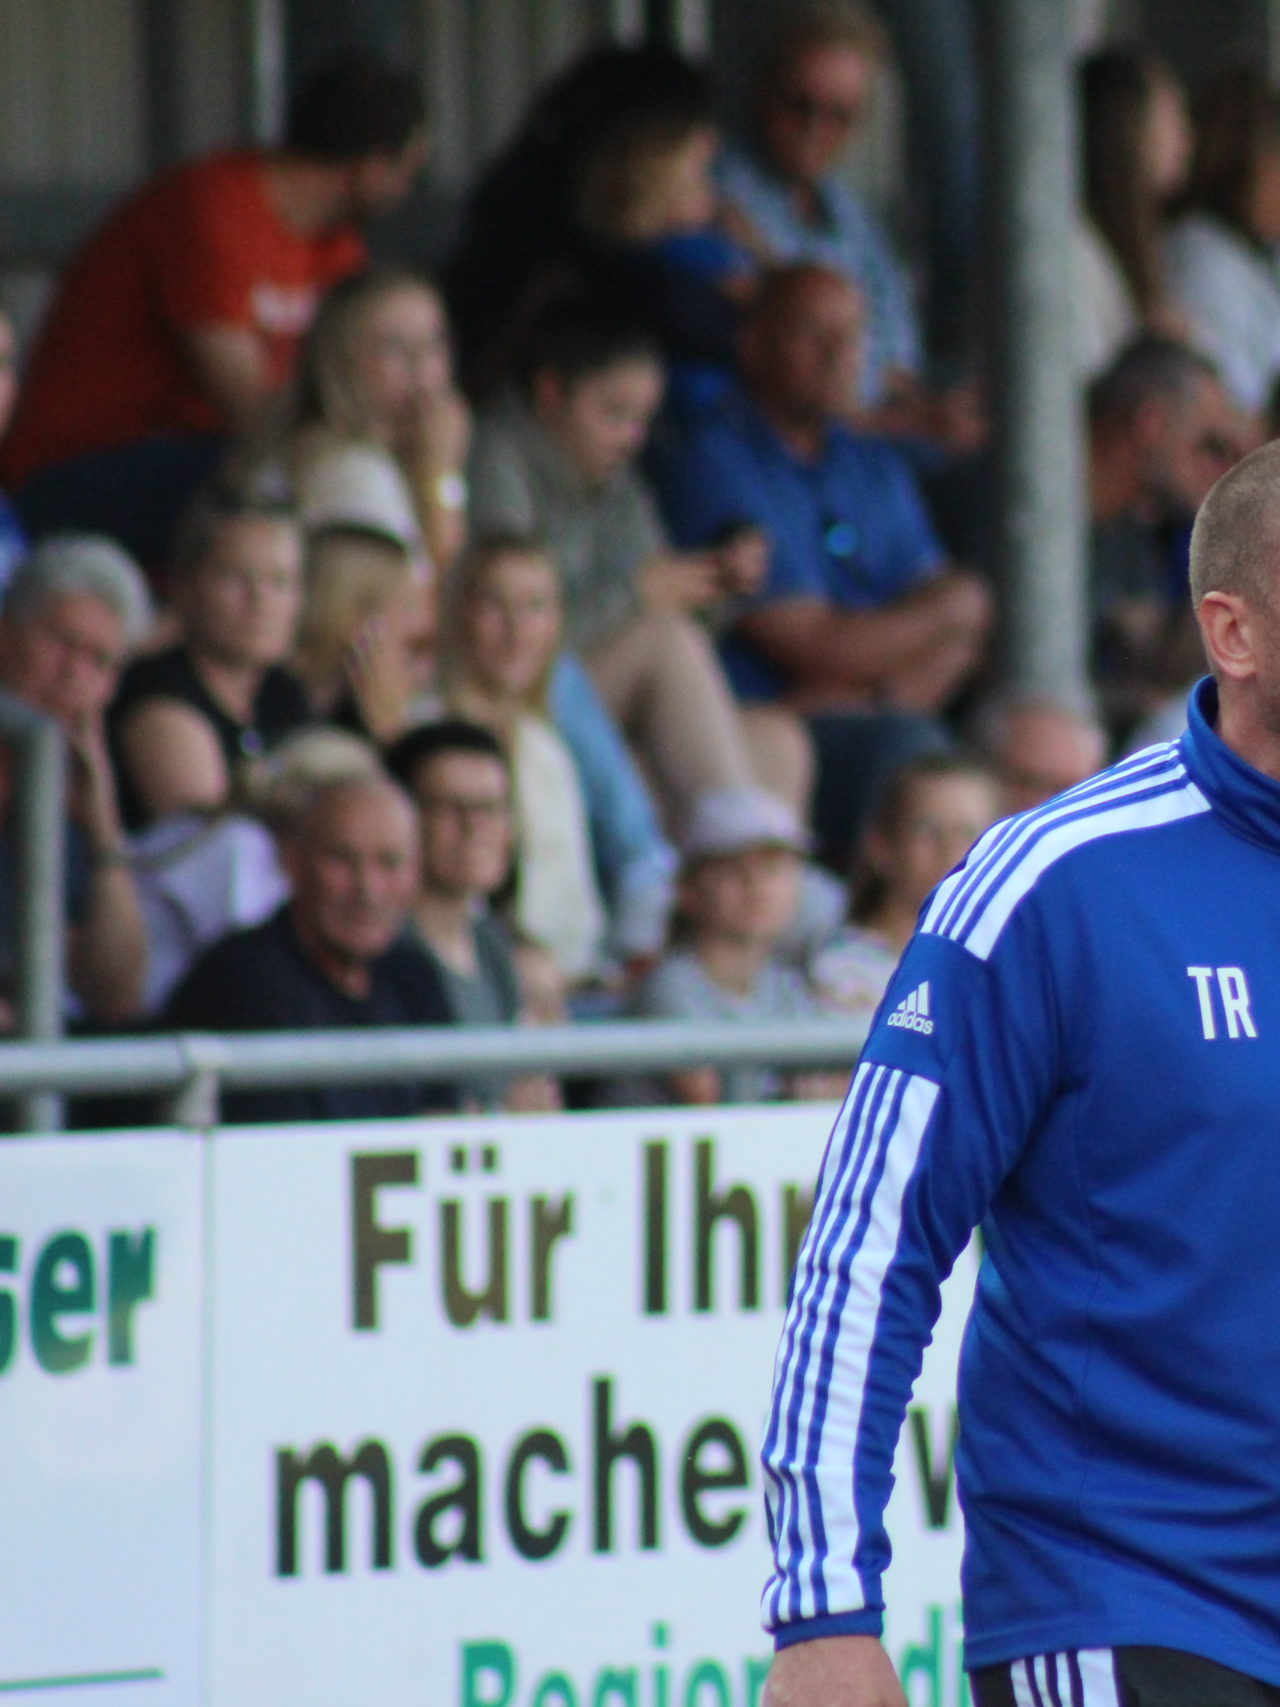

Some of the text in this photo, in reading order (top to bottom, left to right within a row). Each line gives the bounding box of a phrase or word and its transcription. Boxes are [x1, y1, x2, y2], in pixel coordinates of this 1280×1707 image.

[887, 1009, 934, 1035] adidas
[1186, 966, 1258, 1040] TR
[350, 1142, 577, 1333] Für
[276, 1372, 752, 1579] mache
